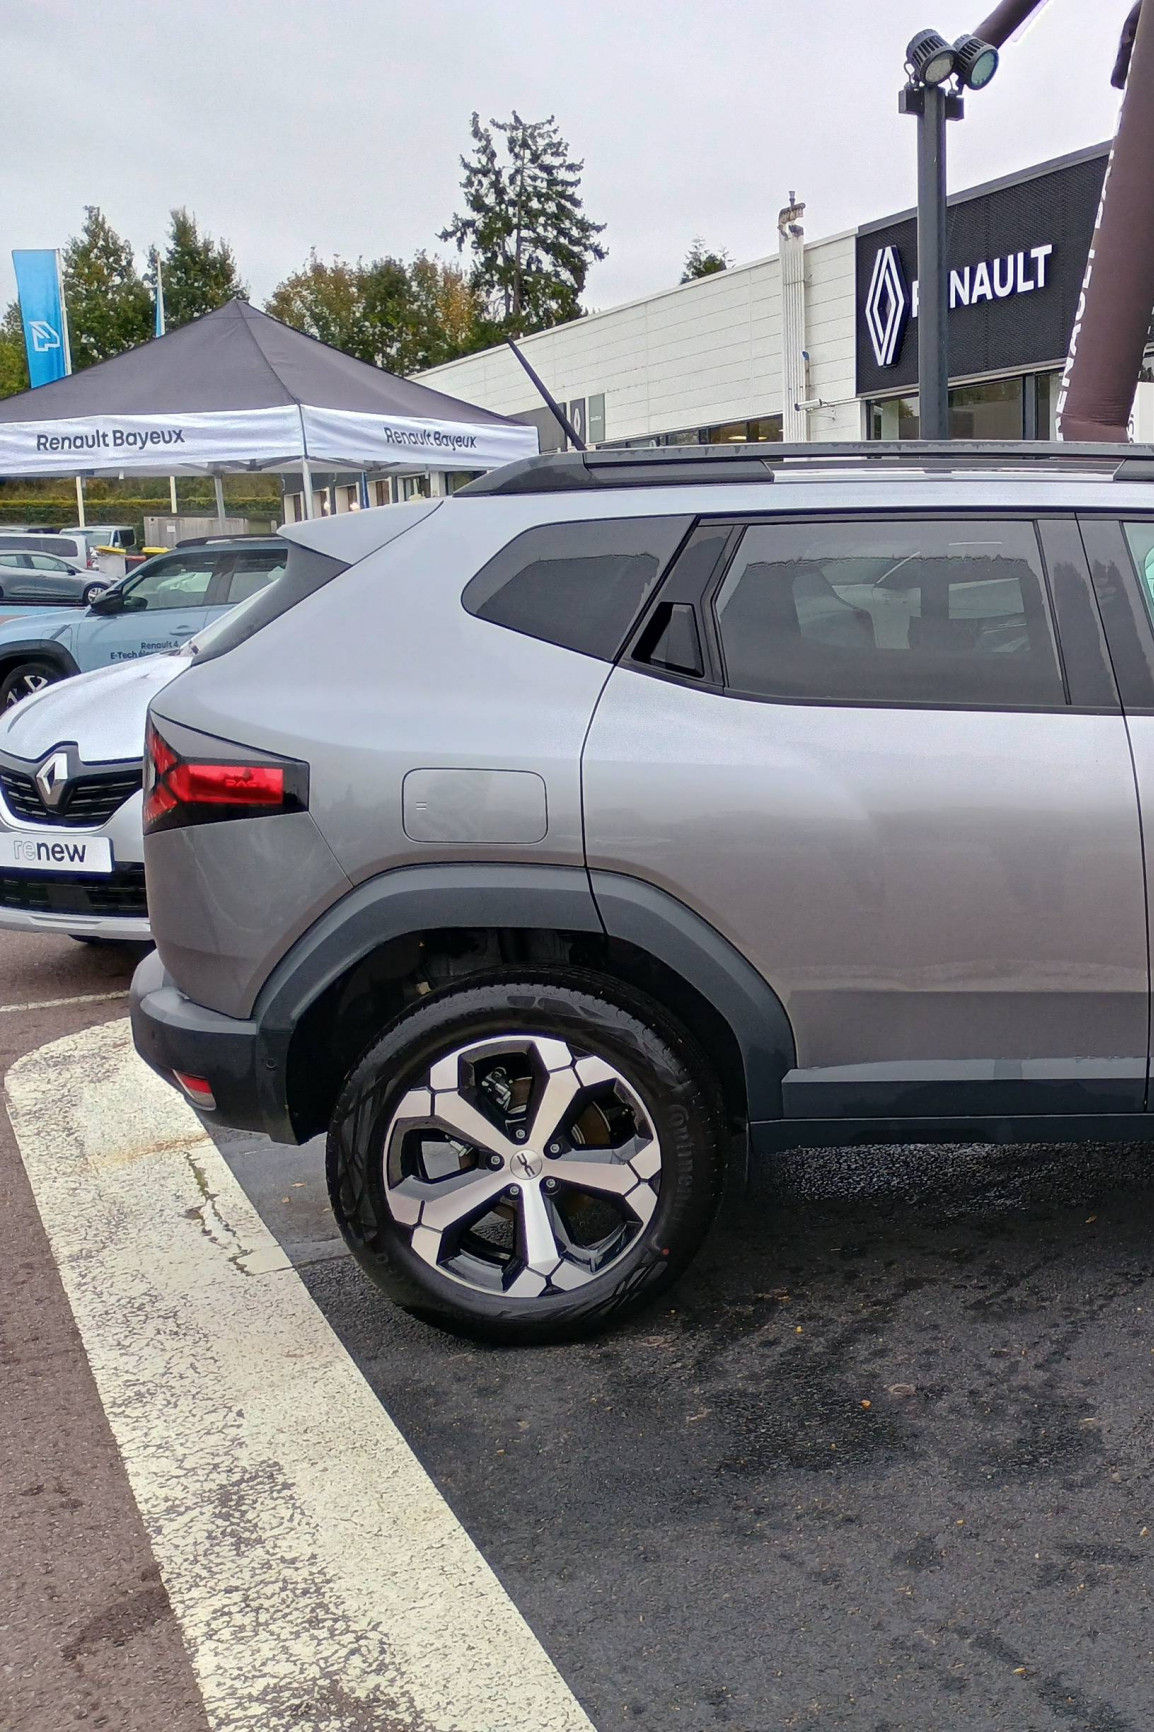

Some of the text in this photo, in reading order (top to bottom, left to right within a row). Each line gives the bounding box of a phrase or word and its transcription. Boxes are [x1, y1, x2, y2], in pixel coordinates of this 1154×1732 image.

[912, 244, 1053, 318] NAULT
[36, 429, 185, 451] Renault Bayeux
[384, 427, 477, 451] Renault Bayeux
[110, 651, 138, 660] E-Tech
[141, 641, 172, 649] Renault
[13, 840, 87, 863] renew
